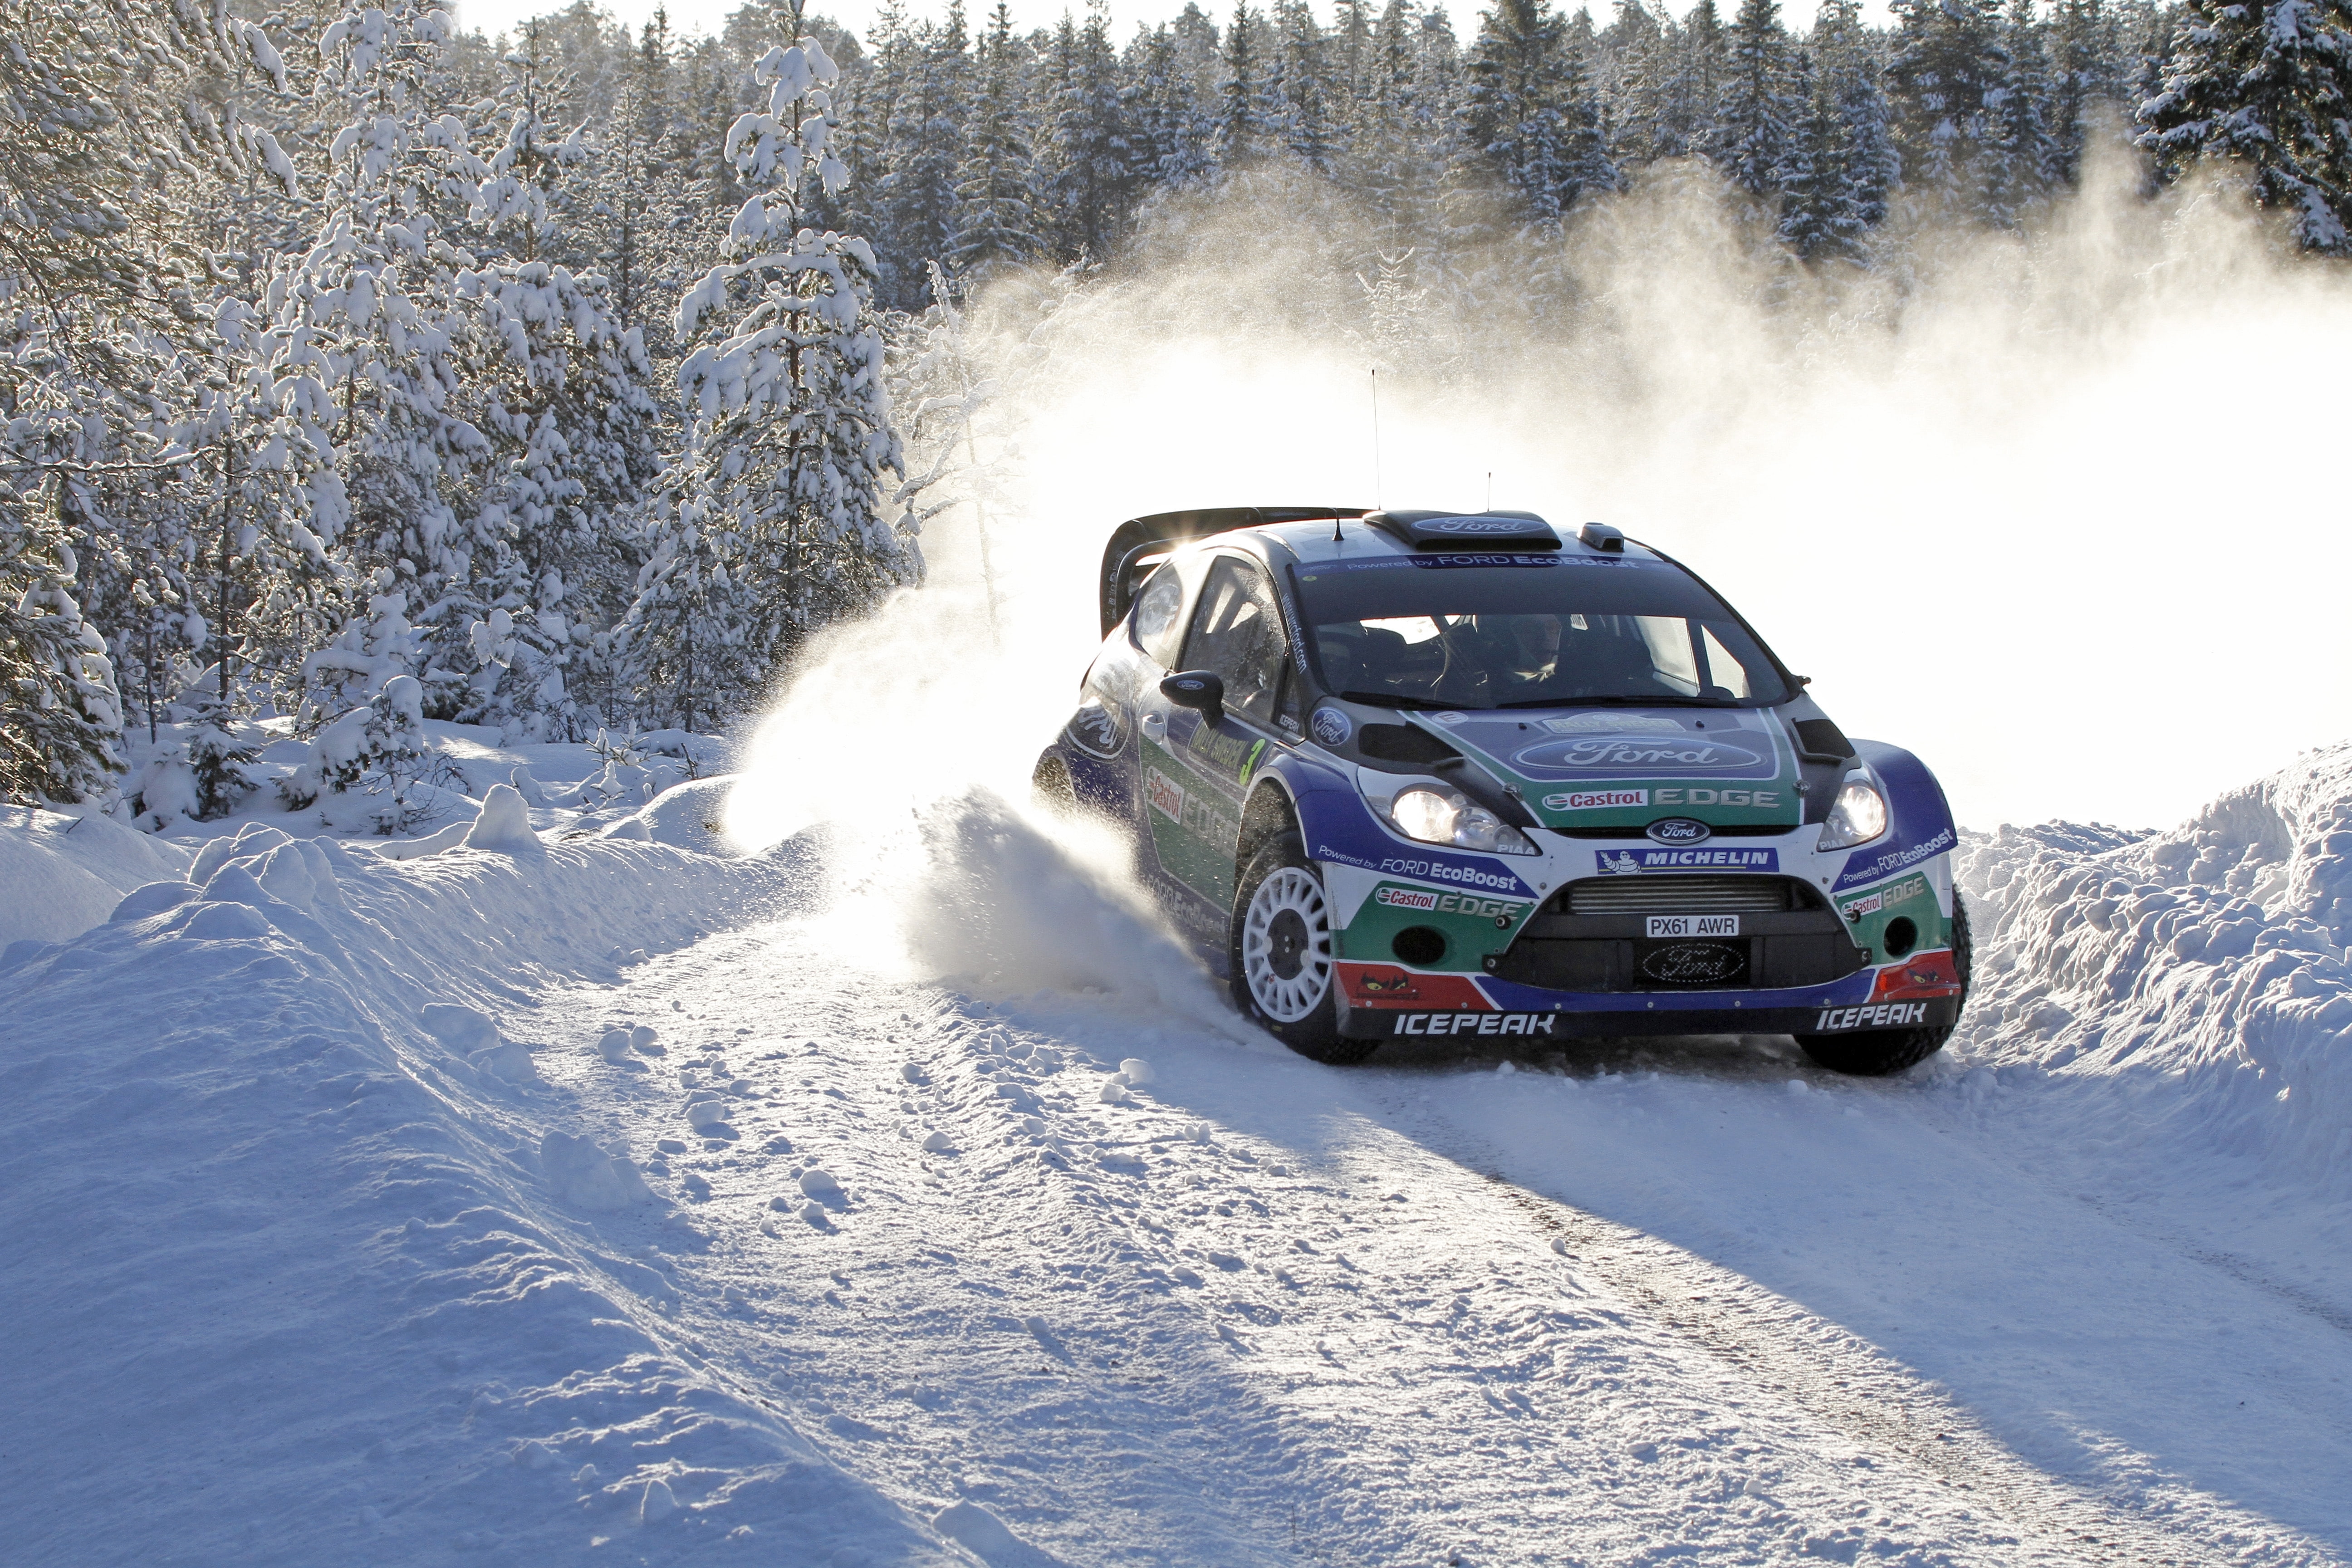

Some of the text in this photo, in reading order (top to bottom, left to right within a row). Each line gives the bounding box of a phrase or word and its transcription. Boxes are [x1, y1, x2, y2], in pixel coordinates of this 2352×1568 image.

[1440, 517, 1523, 531] Ford
[1347, 560, 1412, 570] Powered
[1437, 556, 1510, 566] FORD
[1515, 556, 1639, 568] EcoBoost
[1282, 593, 1307, 674] www.wrcford.com
[1279, 714, 1300, 733] ICEPEAK
[1316, 712, 1344, 743] Ford
[1239, 738, 1265, 786] 3
[1563, 741, 1719, 765] Ford
[1154, 775, 1181, 818] Castrol
[1570, 789, 1780, 808] Castrol EDGE
[1661, 823, 1696, 838] Ford
[1497, 844, 1536, 855] PIAA
[1819, 838, 1846, 851] PIAA
[1843, 828, 1953, 883] Powered by FORD EcoBoost
[1318, 845, 1517, 891] Powered by FORD EcoBoost
[1645, 852, 1769, 865] MICHELIN
[1883, 876, 1924, 907] EDGE
[1391, 890, 1523, 921] Castrol EDGE
[1651, 918, 1735, 935] PX61 AWR
[1661, 949, 1726, 976] Ford
[1394, 1014, 1555, 1034] ICEPEAK
[1816, 1003, 1927, 1030] ICEPEAK
